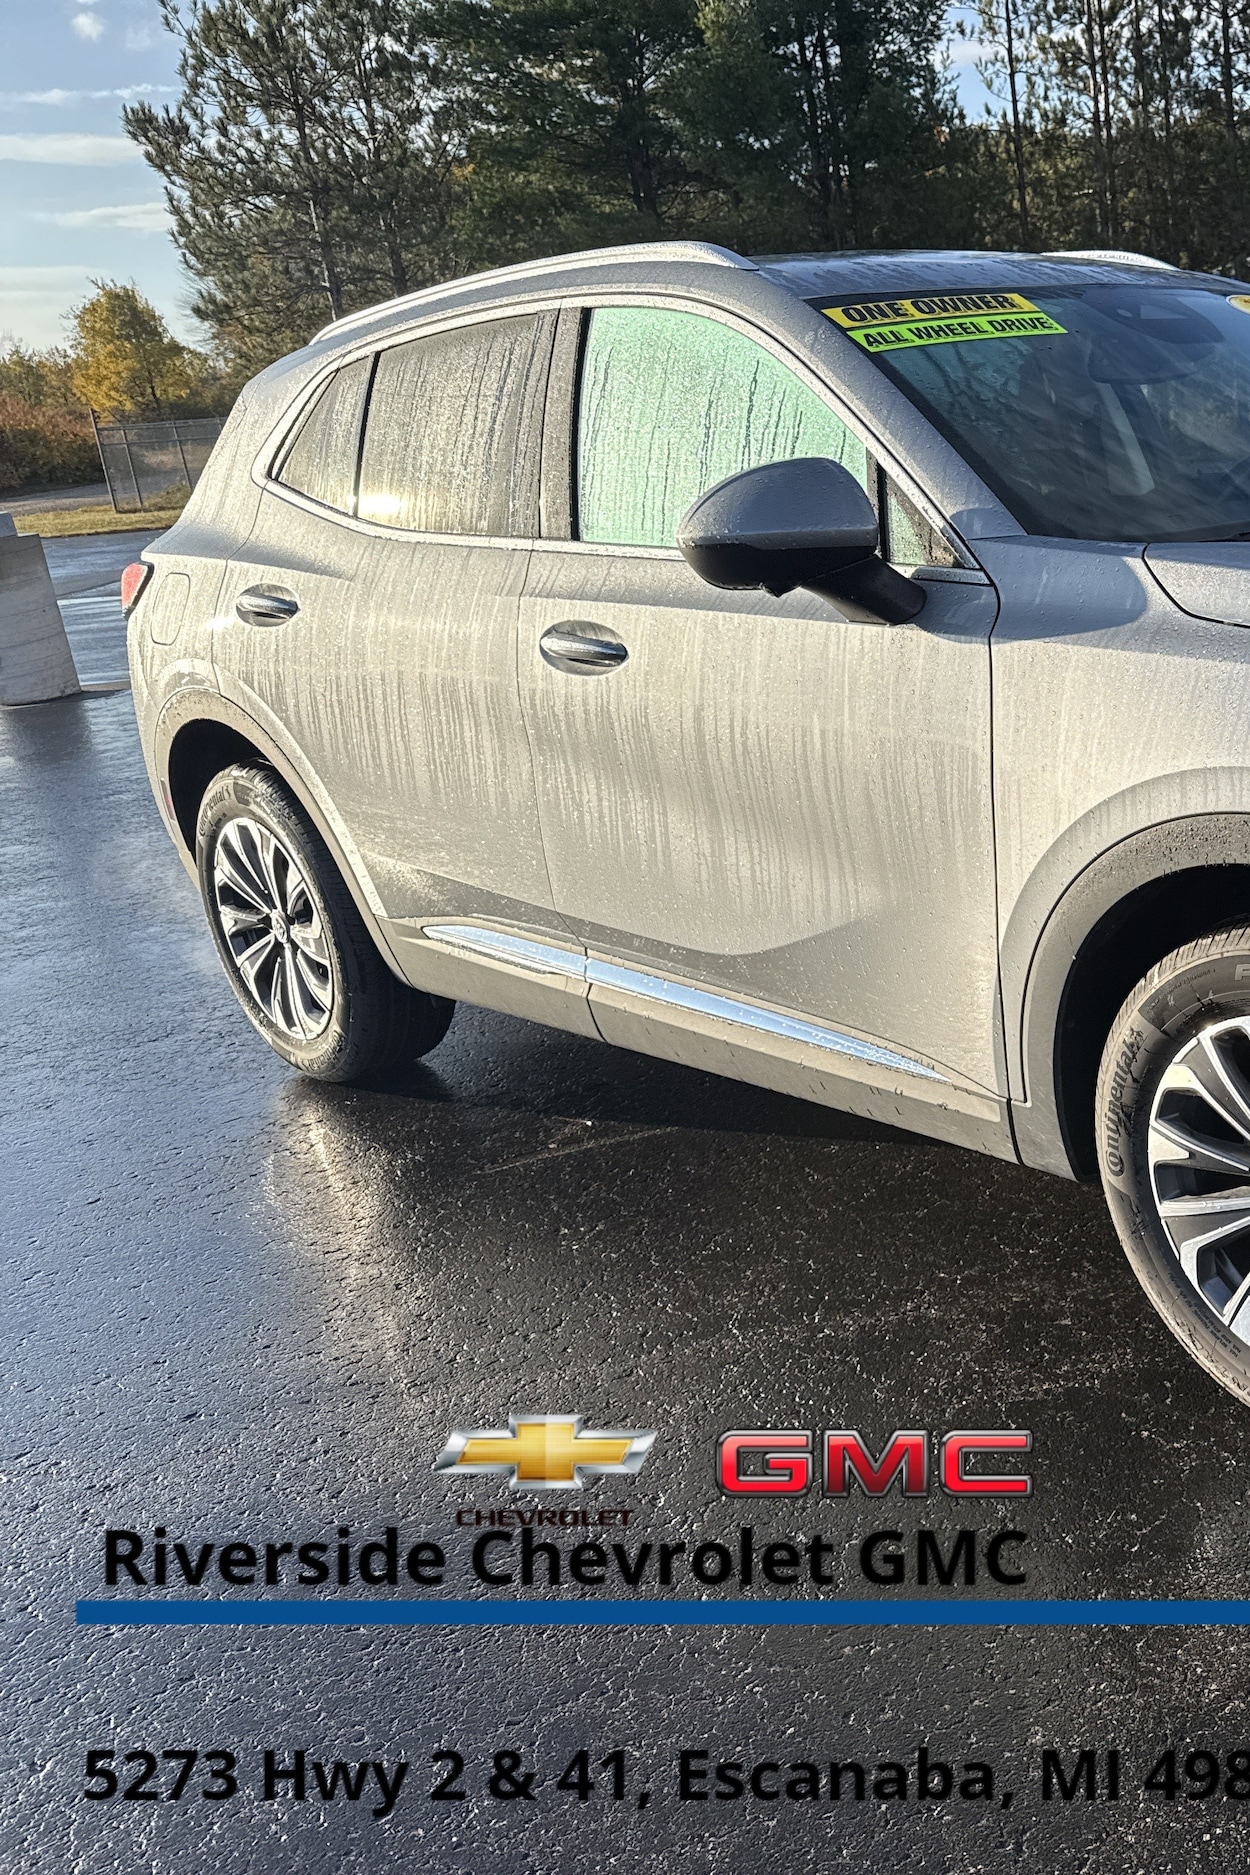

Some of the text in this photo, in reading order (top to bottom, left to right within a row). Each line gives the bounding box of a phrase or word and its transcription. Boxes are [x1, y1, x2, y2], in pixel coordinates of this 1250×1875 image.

[842, 295, 1016, 322] ONE OWNER
[863, 316, 1056, 347] ALL WHEEL DRIVE
[1106, 1038, 1138, 1177] Continental
